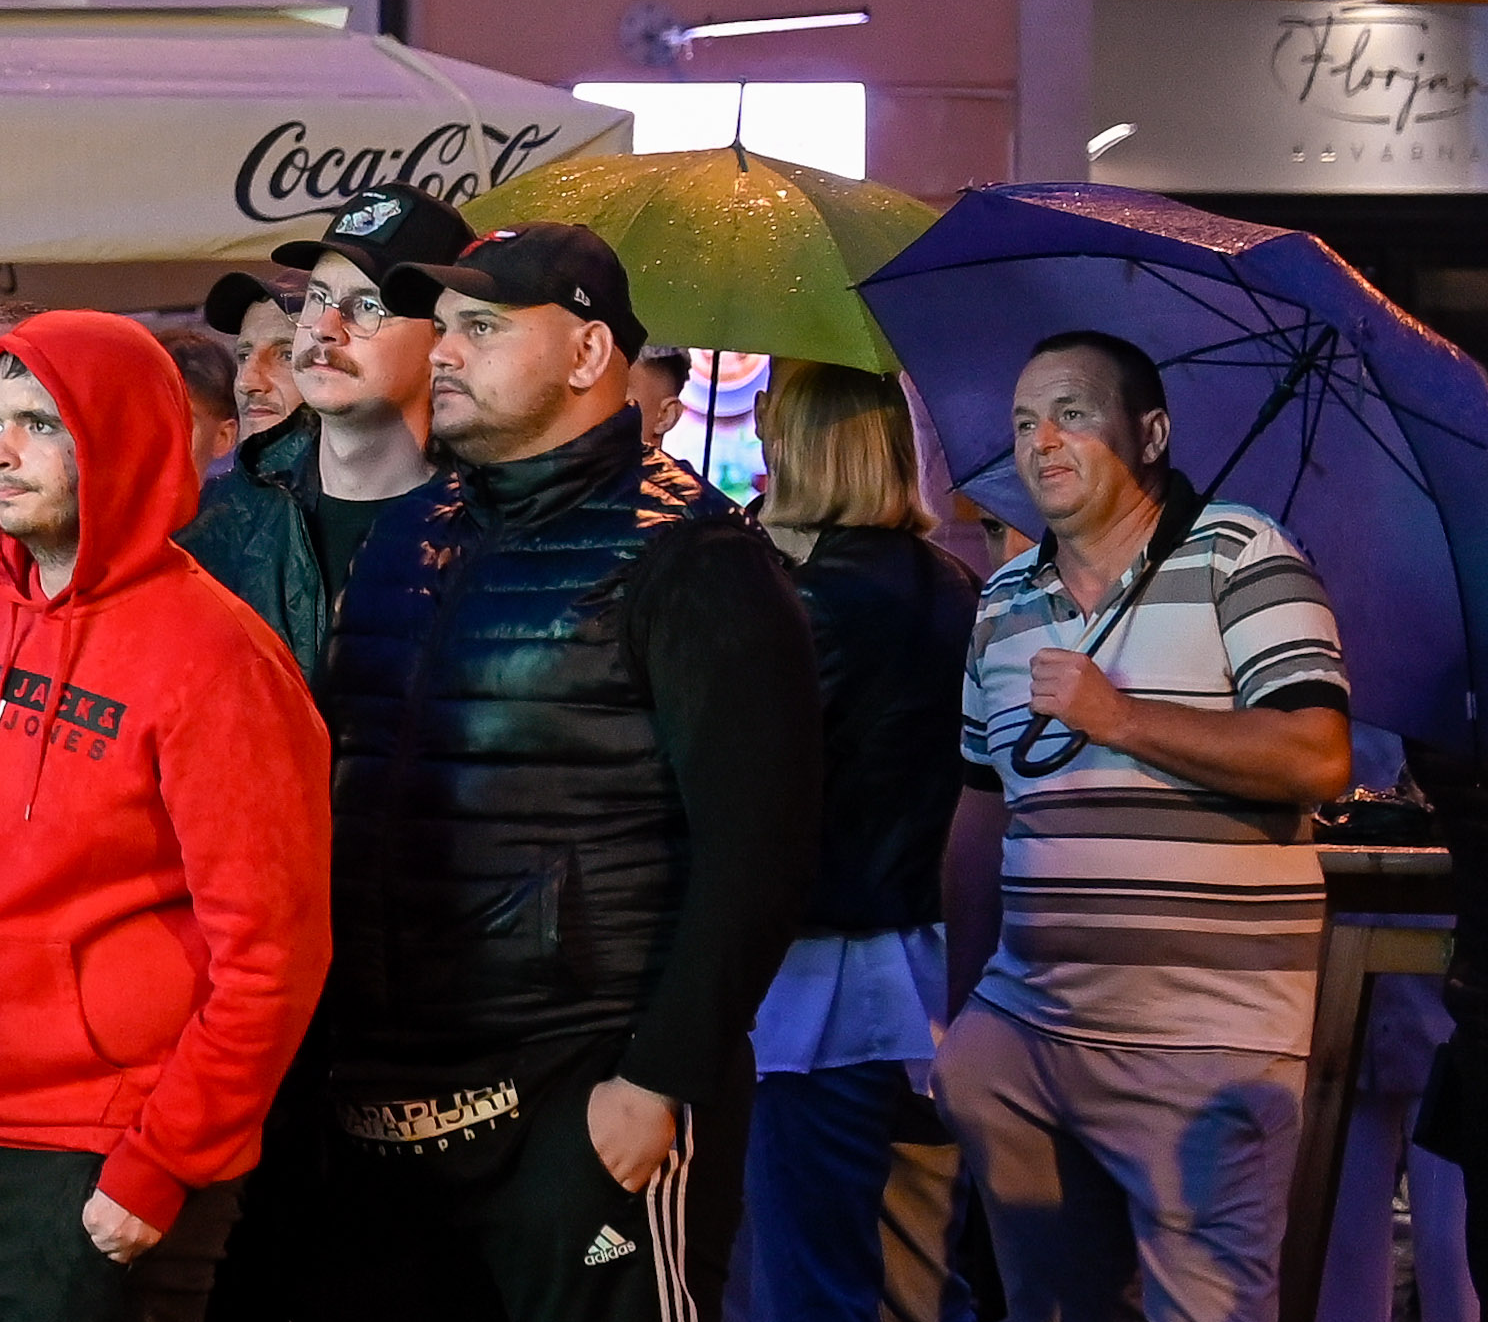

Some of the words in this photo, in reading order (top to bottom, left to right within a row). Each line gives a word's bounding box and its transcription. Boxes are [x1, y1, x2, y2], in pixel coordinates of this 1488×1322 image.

[235, 120, 562, 223] Coca-Col
[3, 709, 107, 761] JONES
[584, 1240, 637, 1267] adidas
